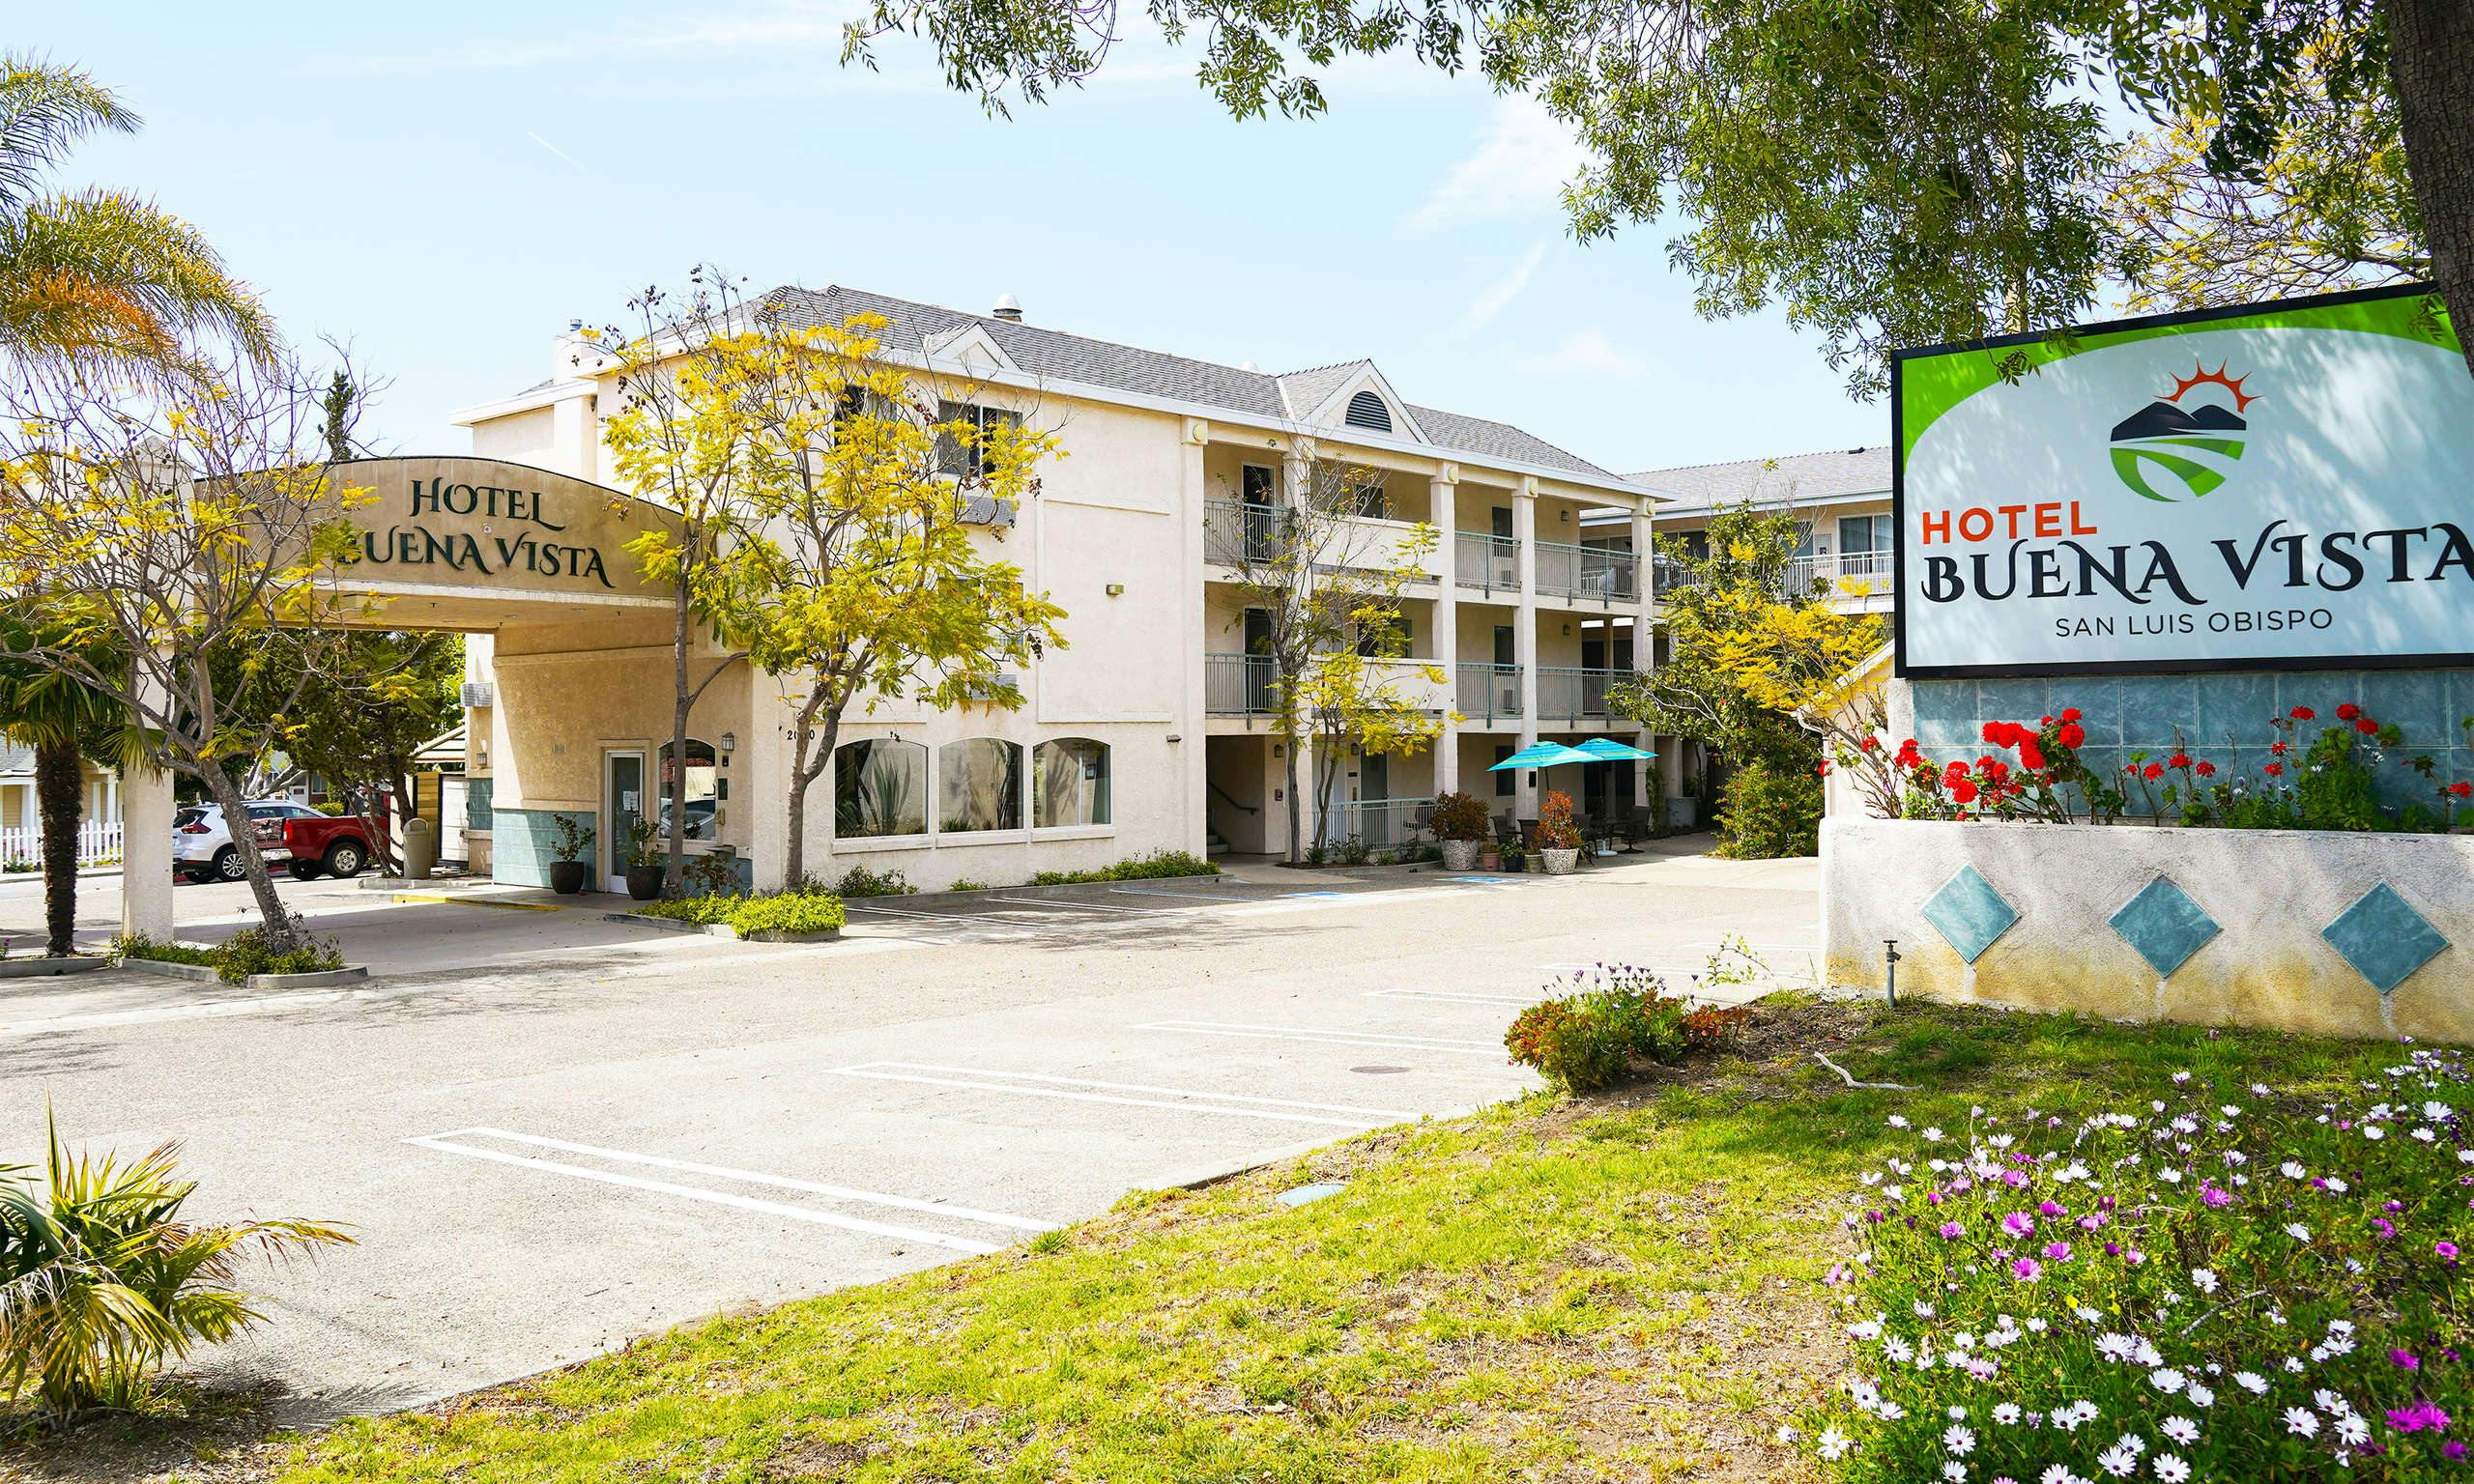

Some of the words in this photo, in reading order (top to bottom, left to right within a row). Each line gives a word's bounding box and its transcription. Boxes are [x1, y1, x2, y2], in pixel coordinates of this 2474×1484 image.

[410, 477, 565, 531] HOTEL
[1922, 500, 2097, 544] HOTEL
[337, 525, 494, 574] UENA
[495, 531, 616, 587] VISTA
[1921, 538, 2208, 605] BUENA
[2210, 520, 2474, 591] VISTA
[2056, 616, 2114, 638] SAN
[2129, 614, 2194, 635] LUIS
[2208, 609, 2333, 633] OBISPO
[787, 729, 815, 741] 20
